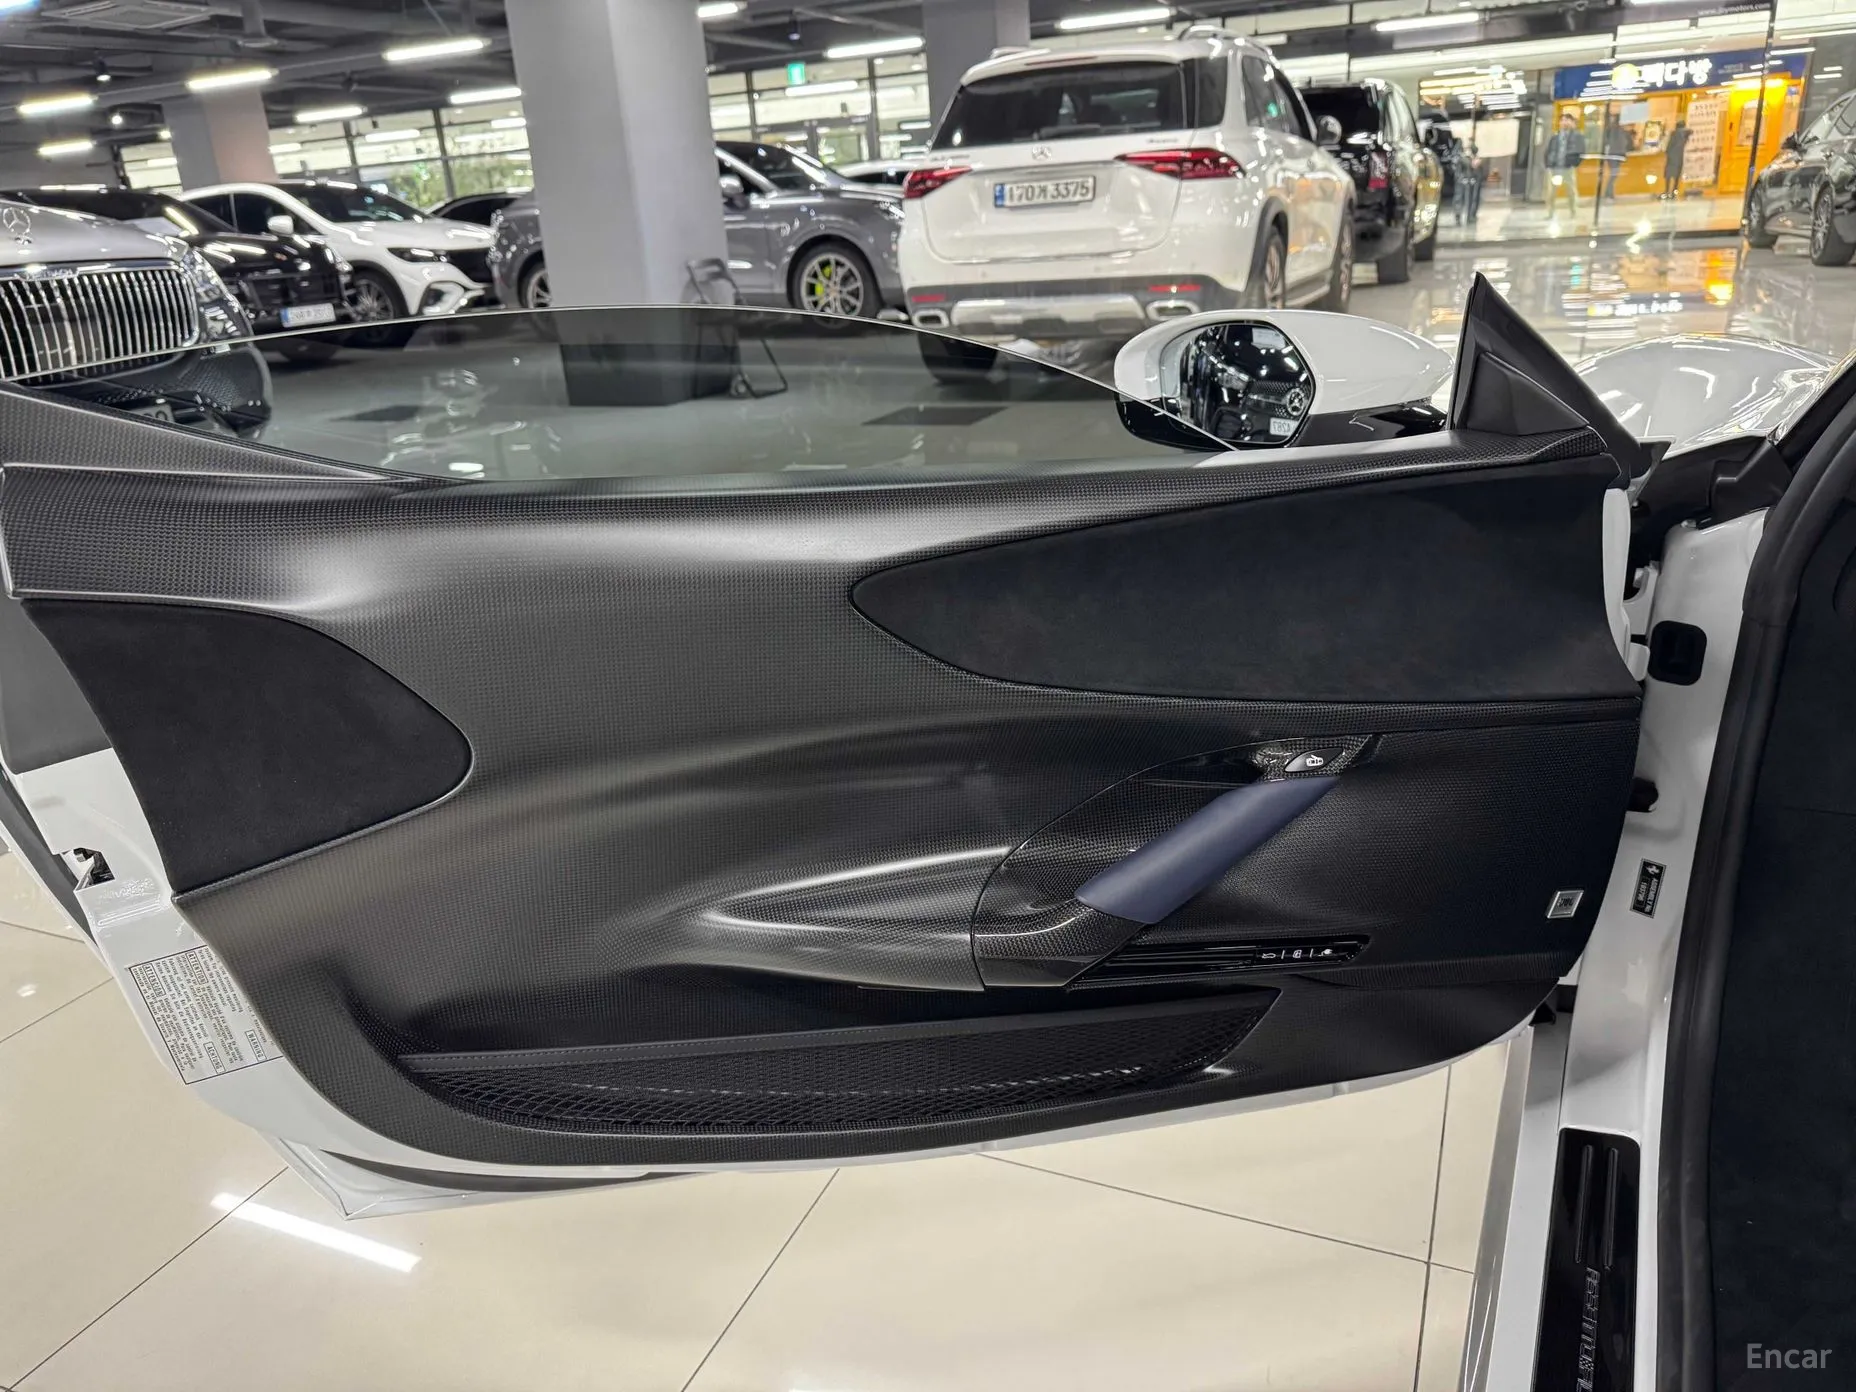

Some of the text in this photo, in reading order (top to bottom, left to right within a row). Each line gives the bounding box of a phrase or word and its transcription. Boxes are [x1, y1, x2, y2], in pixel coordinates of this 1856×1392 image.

[187, 952, 206, 983] ATTENTION
[206, 1045, 222, 1069] ACHTUNG
[247, 1032, 263, 1057] WARNING
